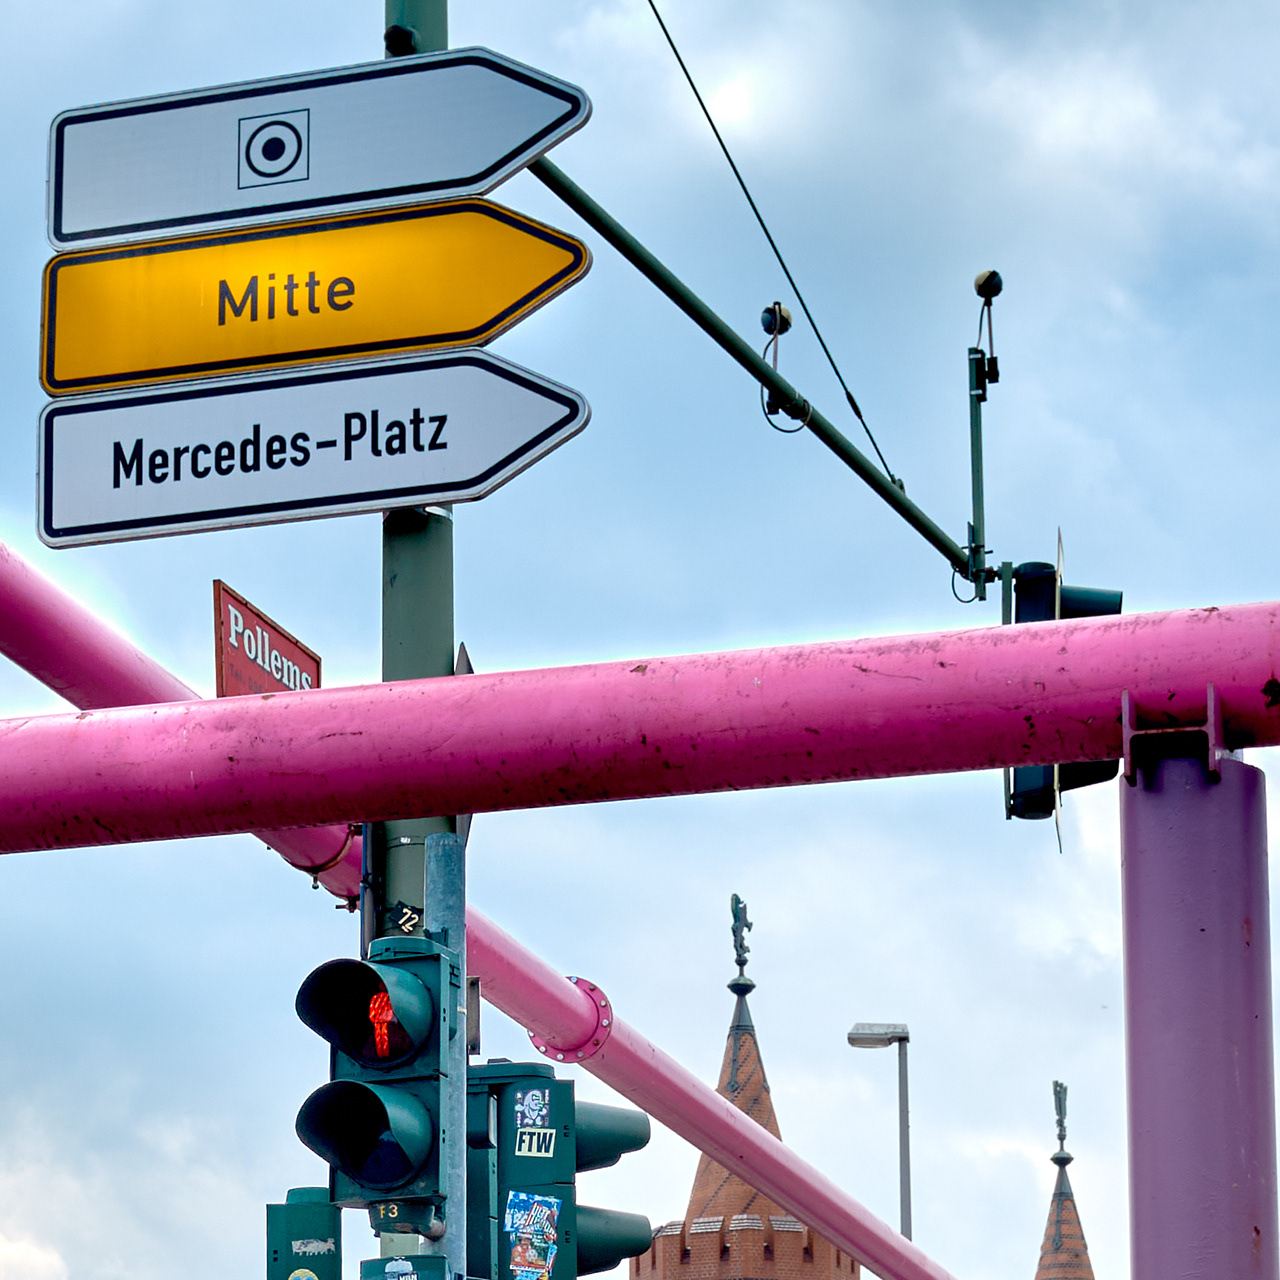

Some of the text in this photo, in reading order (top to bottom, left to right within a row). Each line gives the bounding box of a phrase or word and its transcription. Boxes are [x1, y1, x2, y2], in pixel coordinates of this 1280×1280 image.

[217, 271, 356, 326] Mitte
[112, 408, 448, 489] Mercedes-Platz
[228, 603, 312, 691] Pollems
[517, 1131, 554, 1154] FTW
